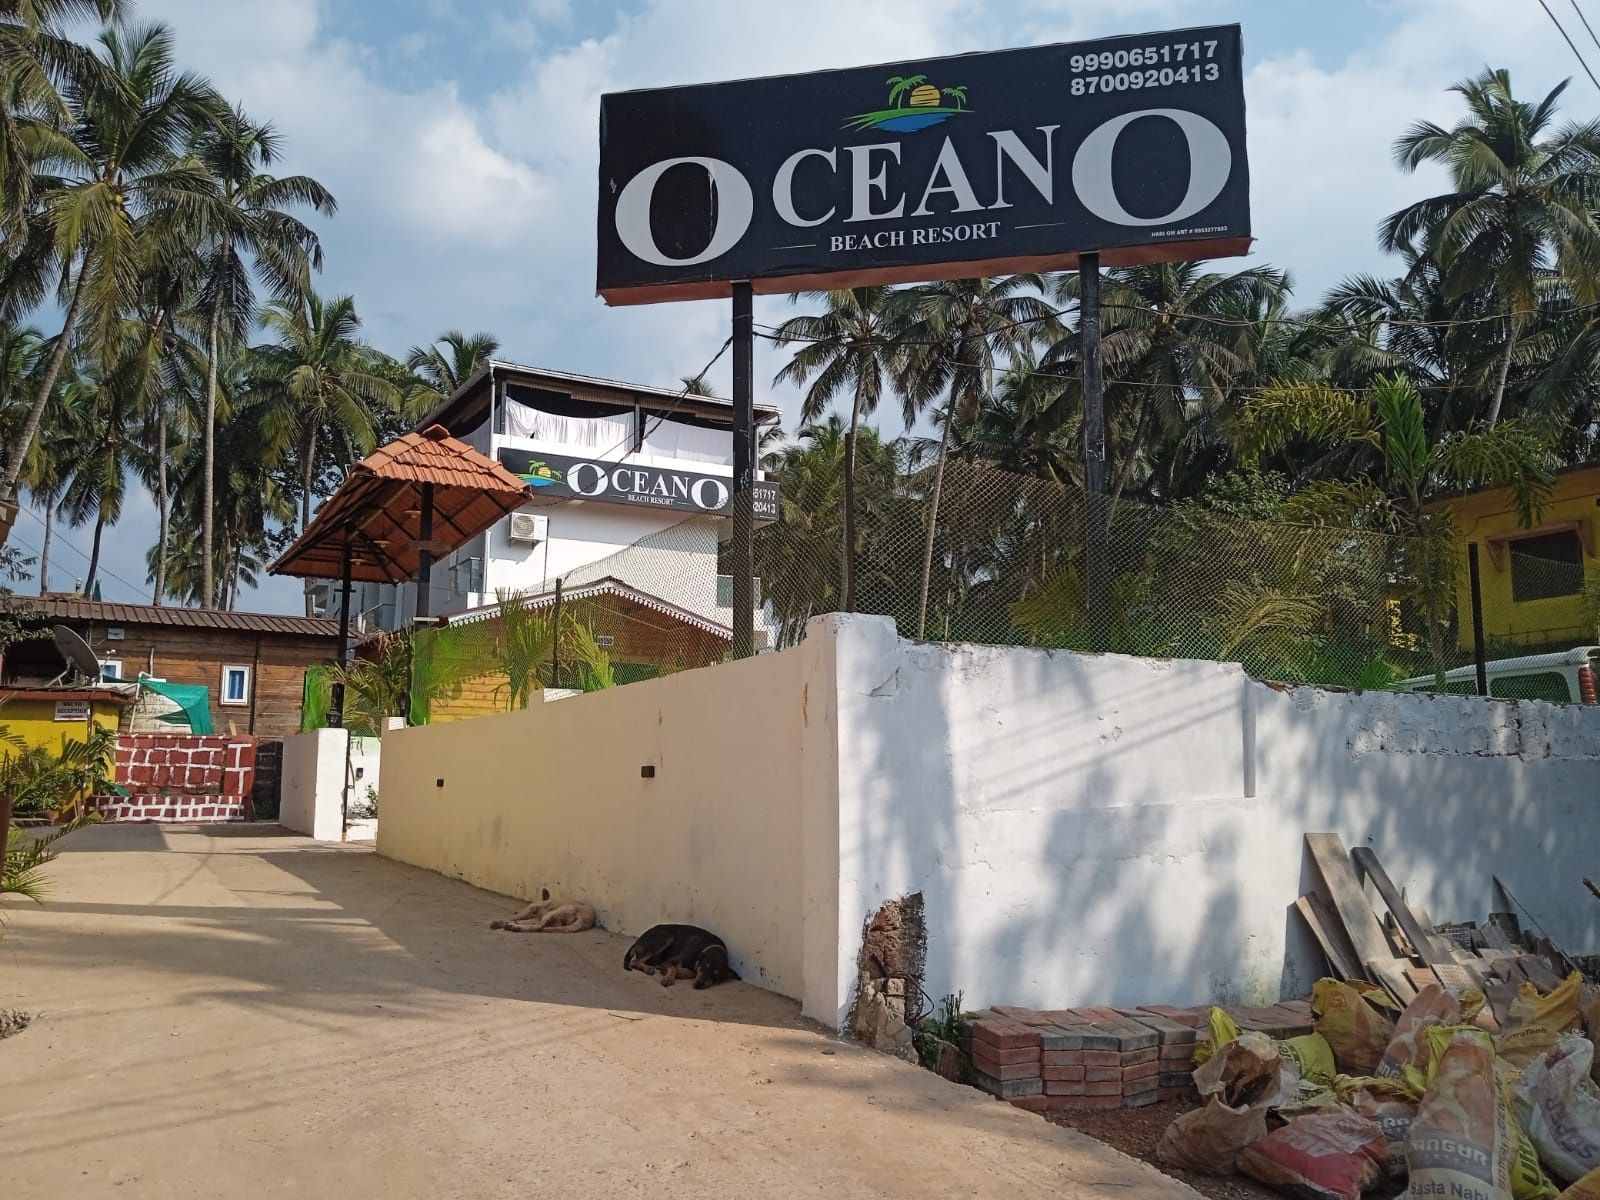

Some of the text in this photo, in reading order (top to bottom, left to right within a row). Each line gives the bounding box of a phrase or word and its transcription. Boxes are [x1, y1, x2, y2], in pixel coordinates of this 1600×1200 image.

[1070, 40, 1218, 73] 9990651717
[1070, 63, 1220, 96] 8700920413
[615, 108, 1232, 267] OCEANO
[829, 221, 1001, 252] BEACH RESORT
[566, 462, 729, 510] OCEANO
[627, 494, 675, 506] BEACH RESORT
